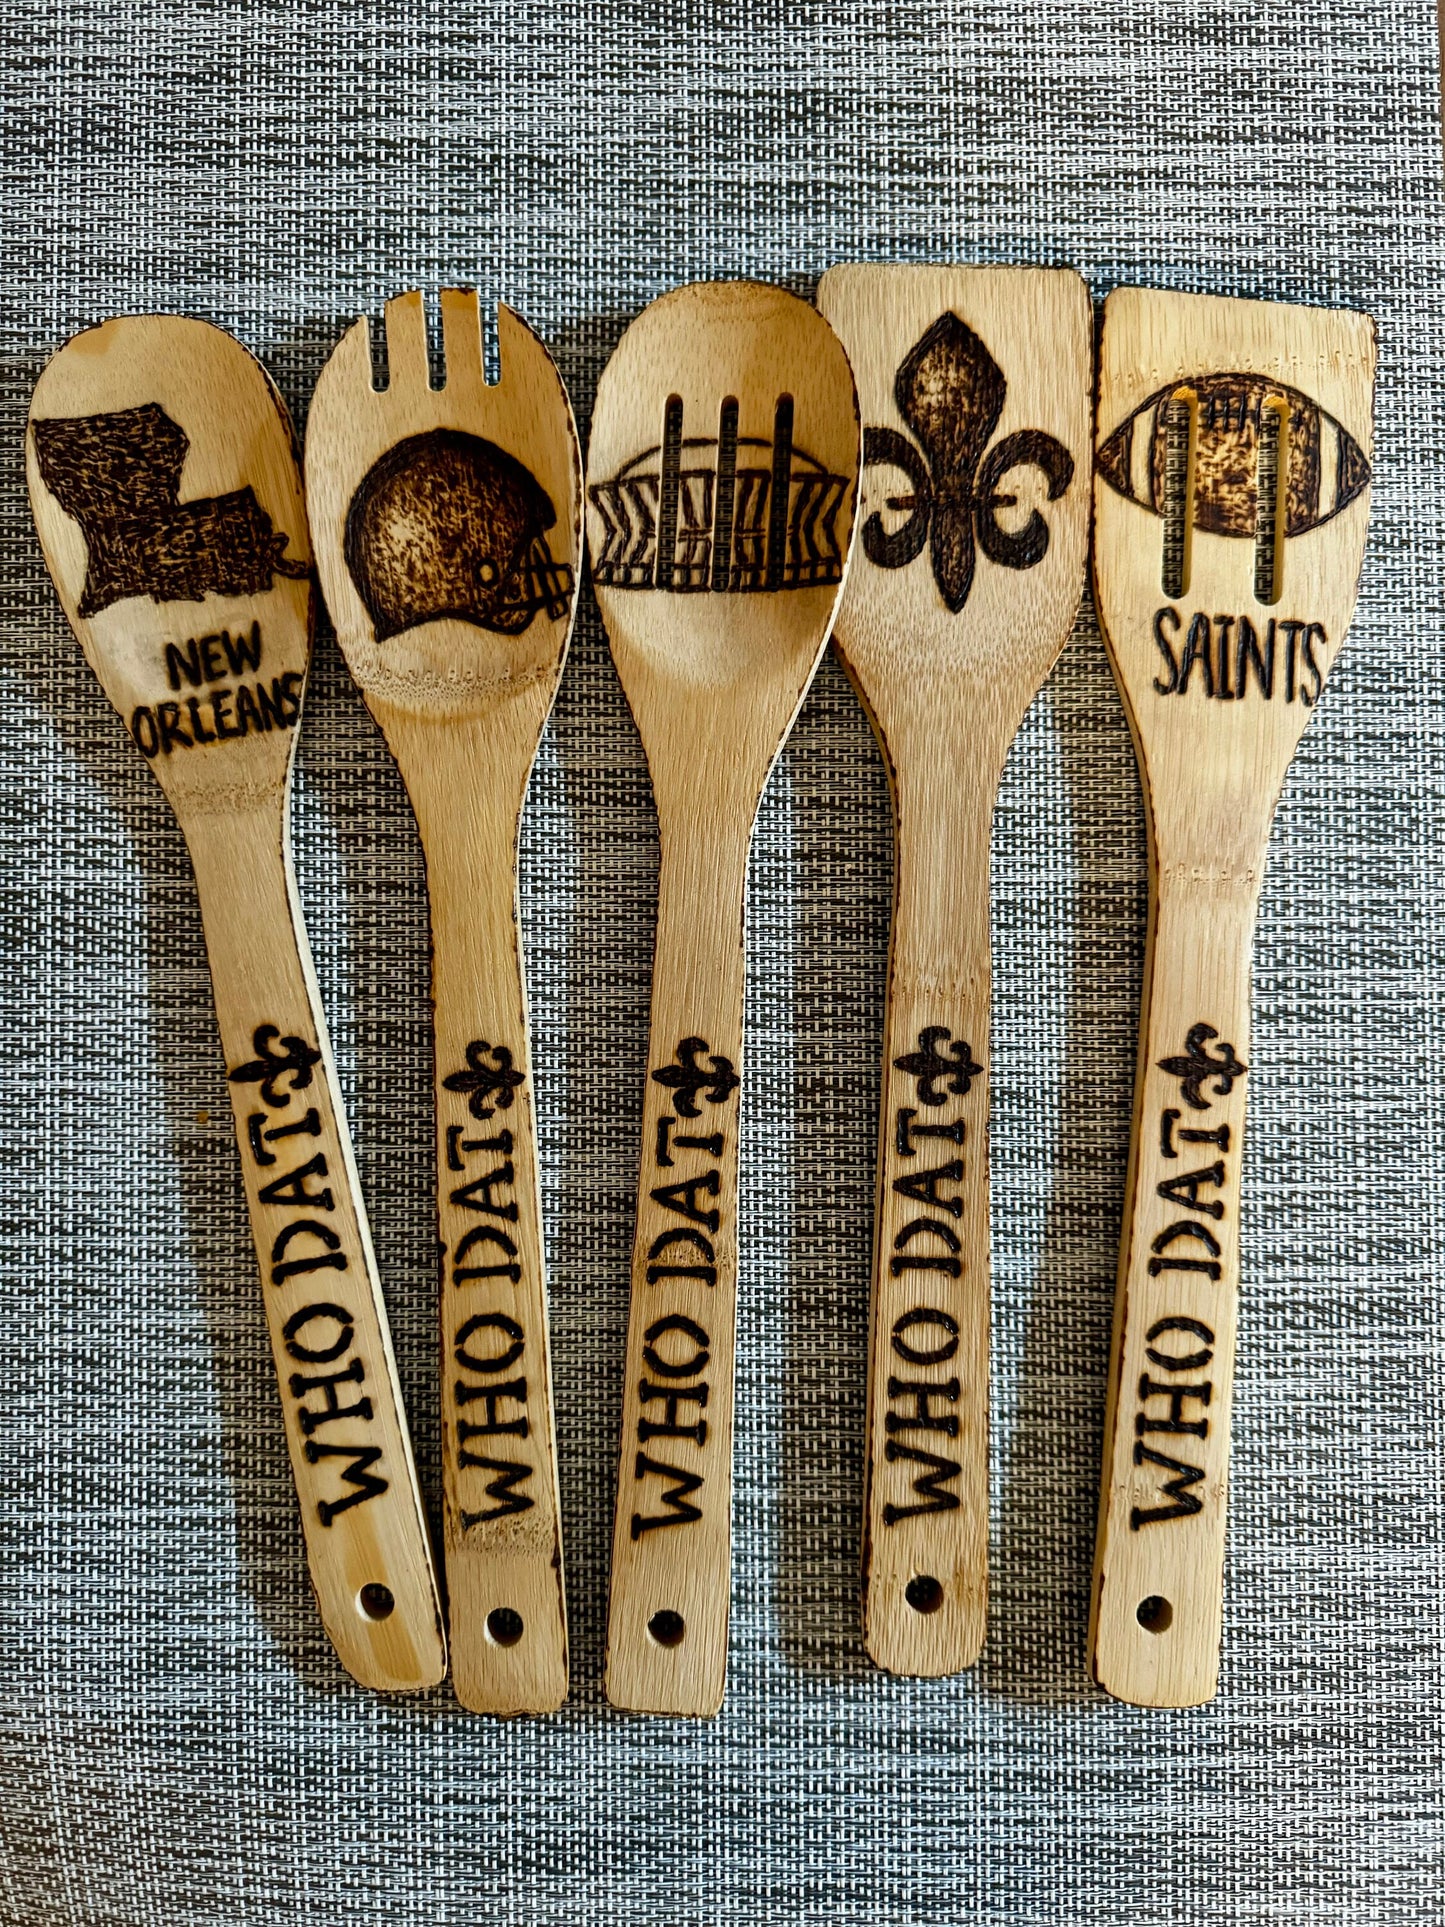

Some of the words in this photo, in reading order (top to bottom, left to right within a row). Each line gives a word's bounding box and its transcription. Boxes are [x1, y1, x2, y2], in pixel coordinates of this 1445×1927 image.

[132, 672, 303, 759] ORLEANS
[165, 620, 261, 691] NEW
[1153, 606, 1327, 707] SAINTS
[248, 1108, 347, 1287] DAT
[447, 1126, 521, 1287] DAT
[646, 1116, 723, 1287] DAT
[890, 1108, 965, 1278] DAT
[1148, 1108, 1230, 1281] DAT
[283, 1303, 388, 1527] WHO
[454, 1313, 535, 1529] WHO
[631, 1313, 710, 1540] WHO
[884, 1307, 962, 1525] WHO
[1130, 1316, 1215, 1531] WHO
